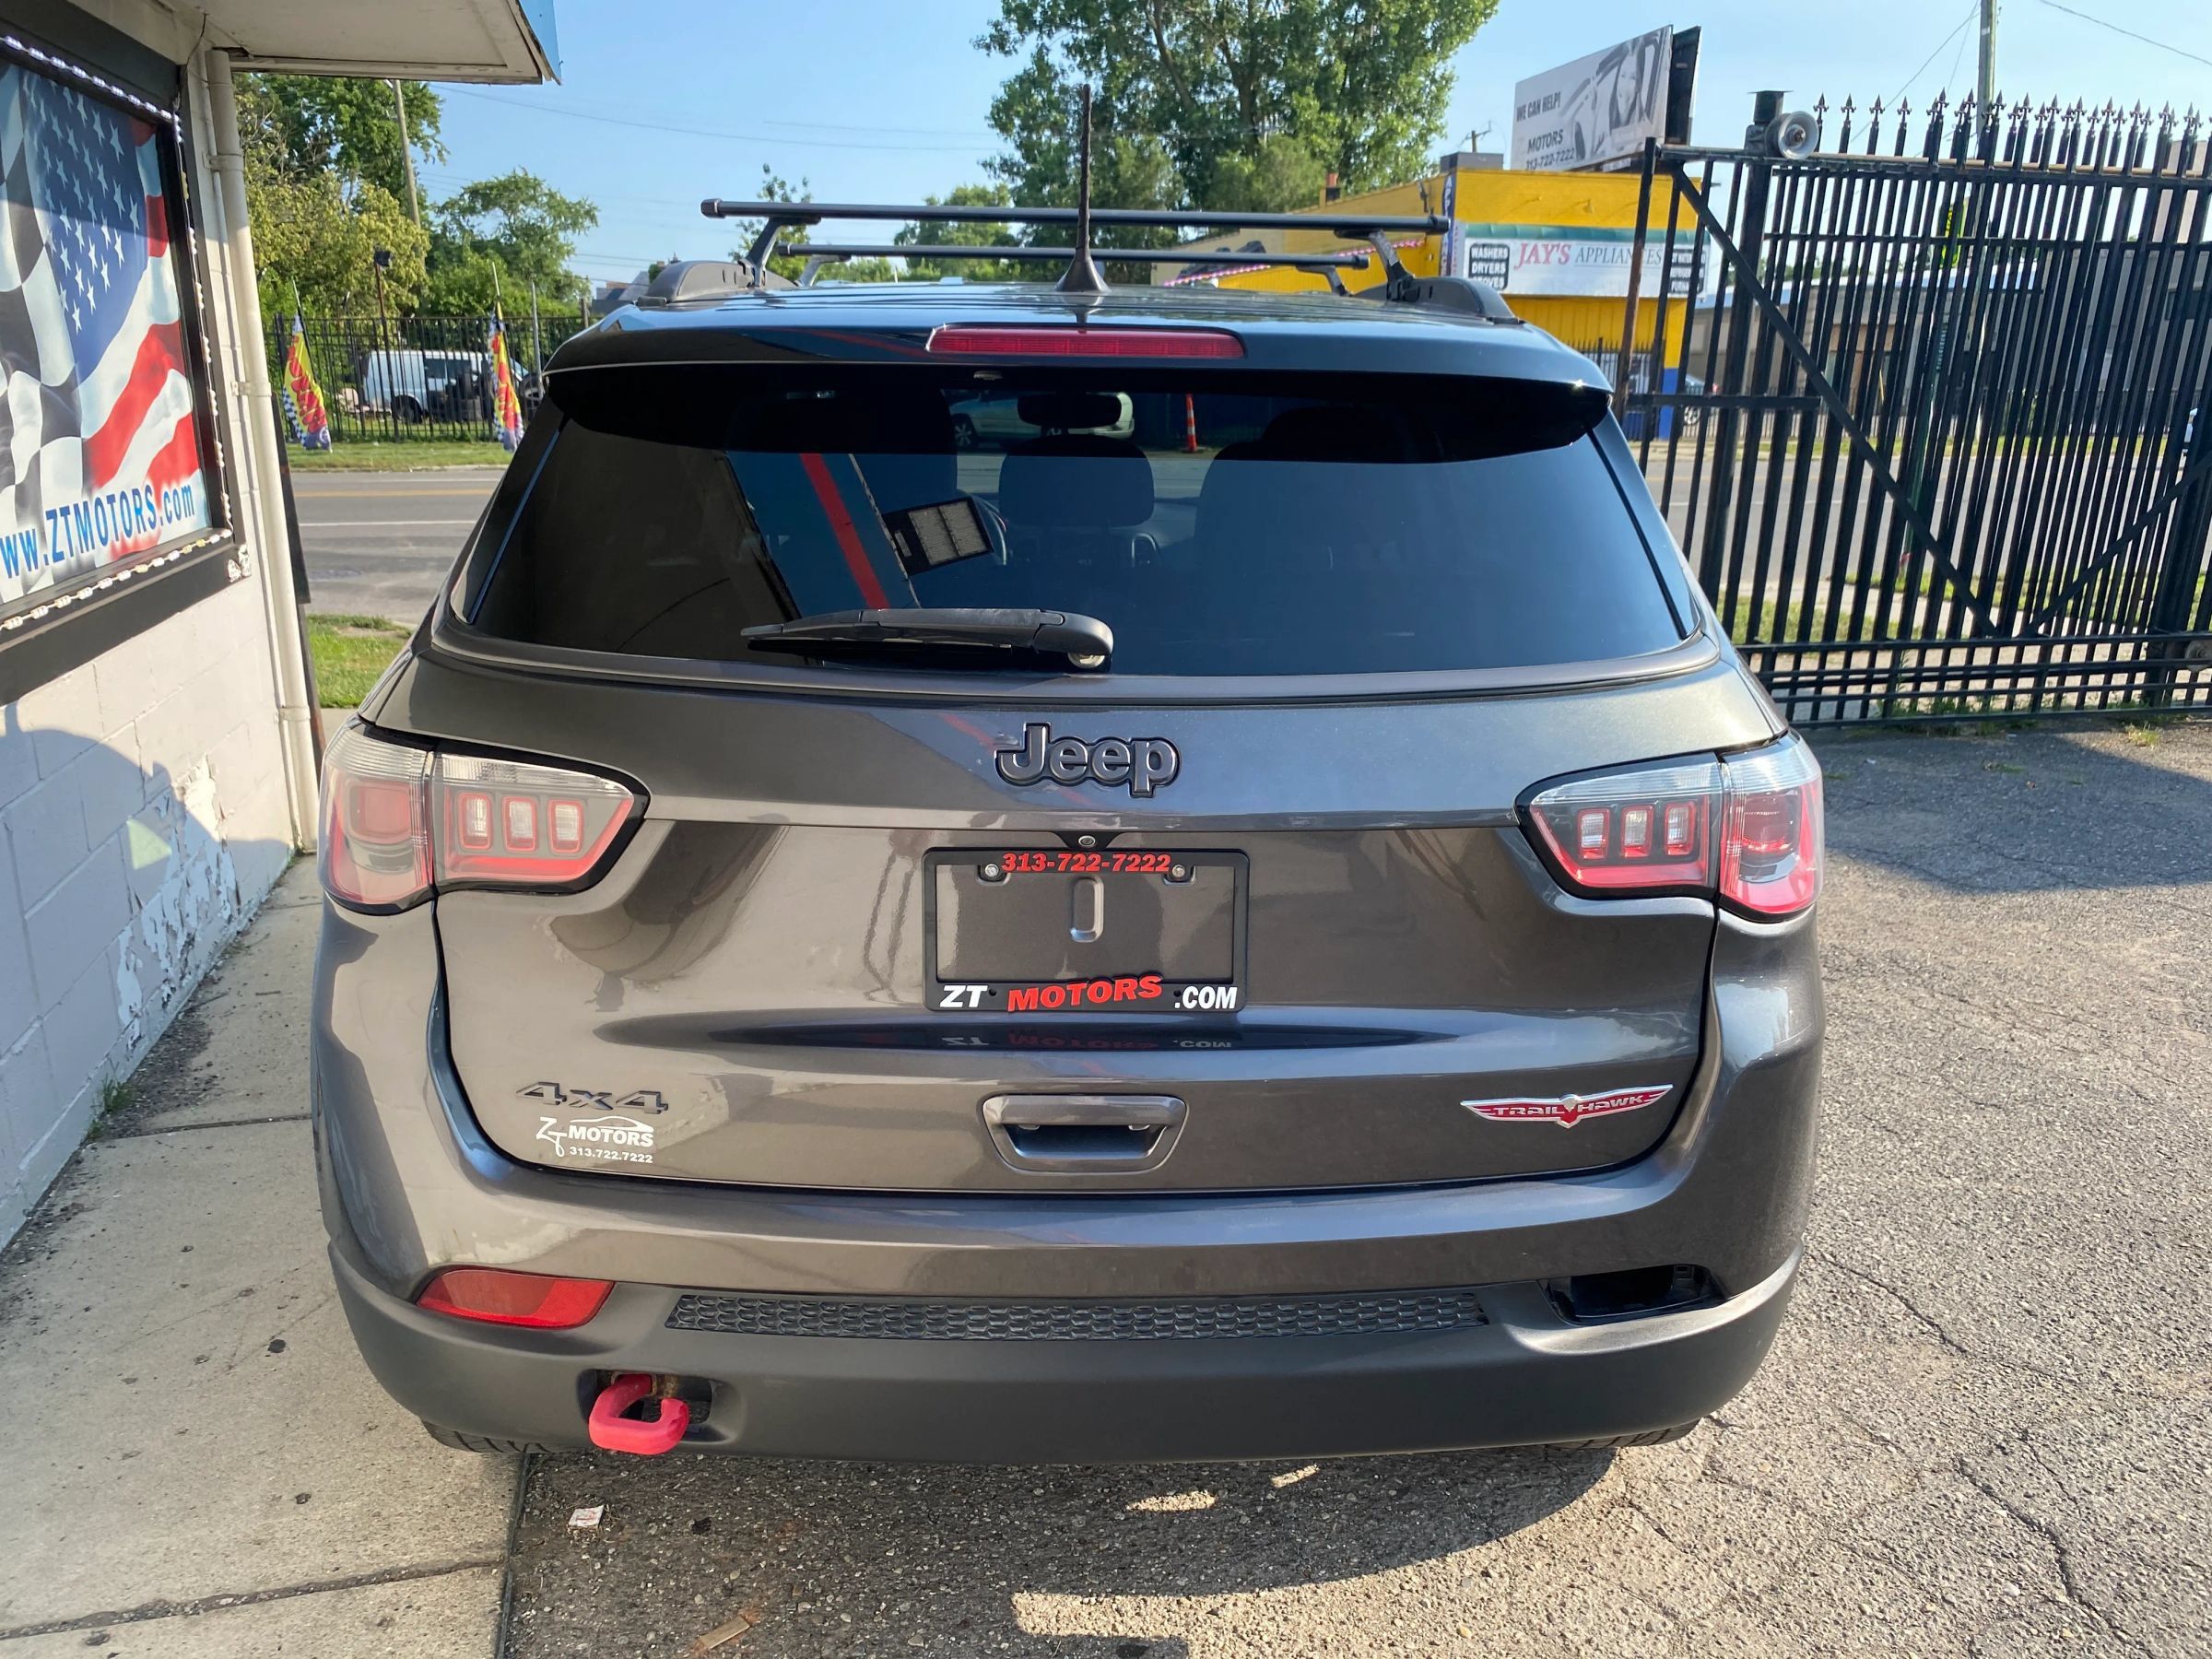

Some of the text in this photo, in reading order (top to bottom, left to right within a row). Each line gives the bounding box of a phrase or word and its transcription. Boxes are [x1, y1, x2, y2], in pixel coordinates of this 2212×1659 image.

[1516, 91, 1561, 123] WE CAN HELP!
[1527, 128, 1564, 154] MOTORS
[1471, 246, 1509, 259] WASHERS
[1514, 242, 1571, 270] JAY'S
[1575, 246, 1663, 265] APPLIANES
[1471, 261, 1506, 274] DRYERS
[1473, 276, 1505, 289] OVES
[994, 722, 1182, 798] Jeep
[1001, 852, 1172, 873] 313-722-7222
[939, 974, 1238, 1012] ZT MOTORS .COM
[1494, 1095, 1644, 1116] TRAIL HAWK
[567, 1124, 654, 1148] MOTORS
[569, 1146, 654, 1164] 313.722.7222
